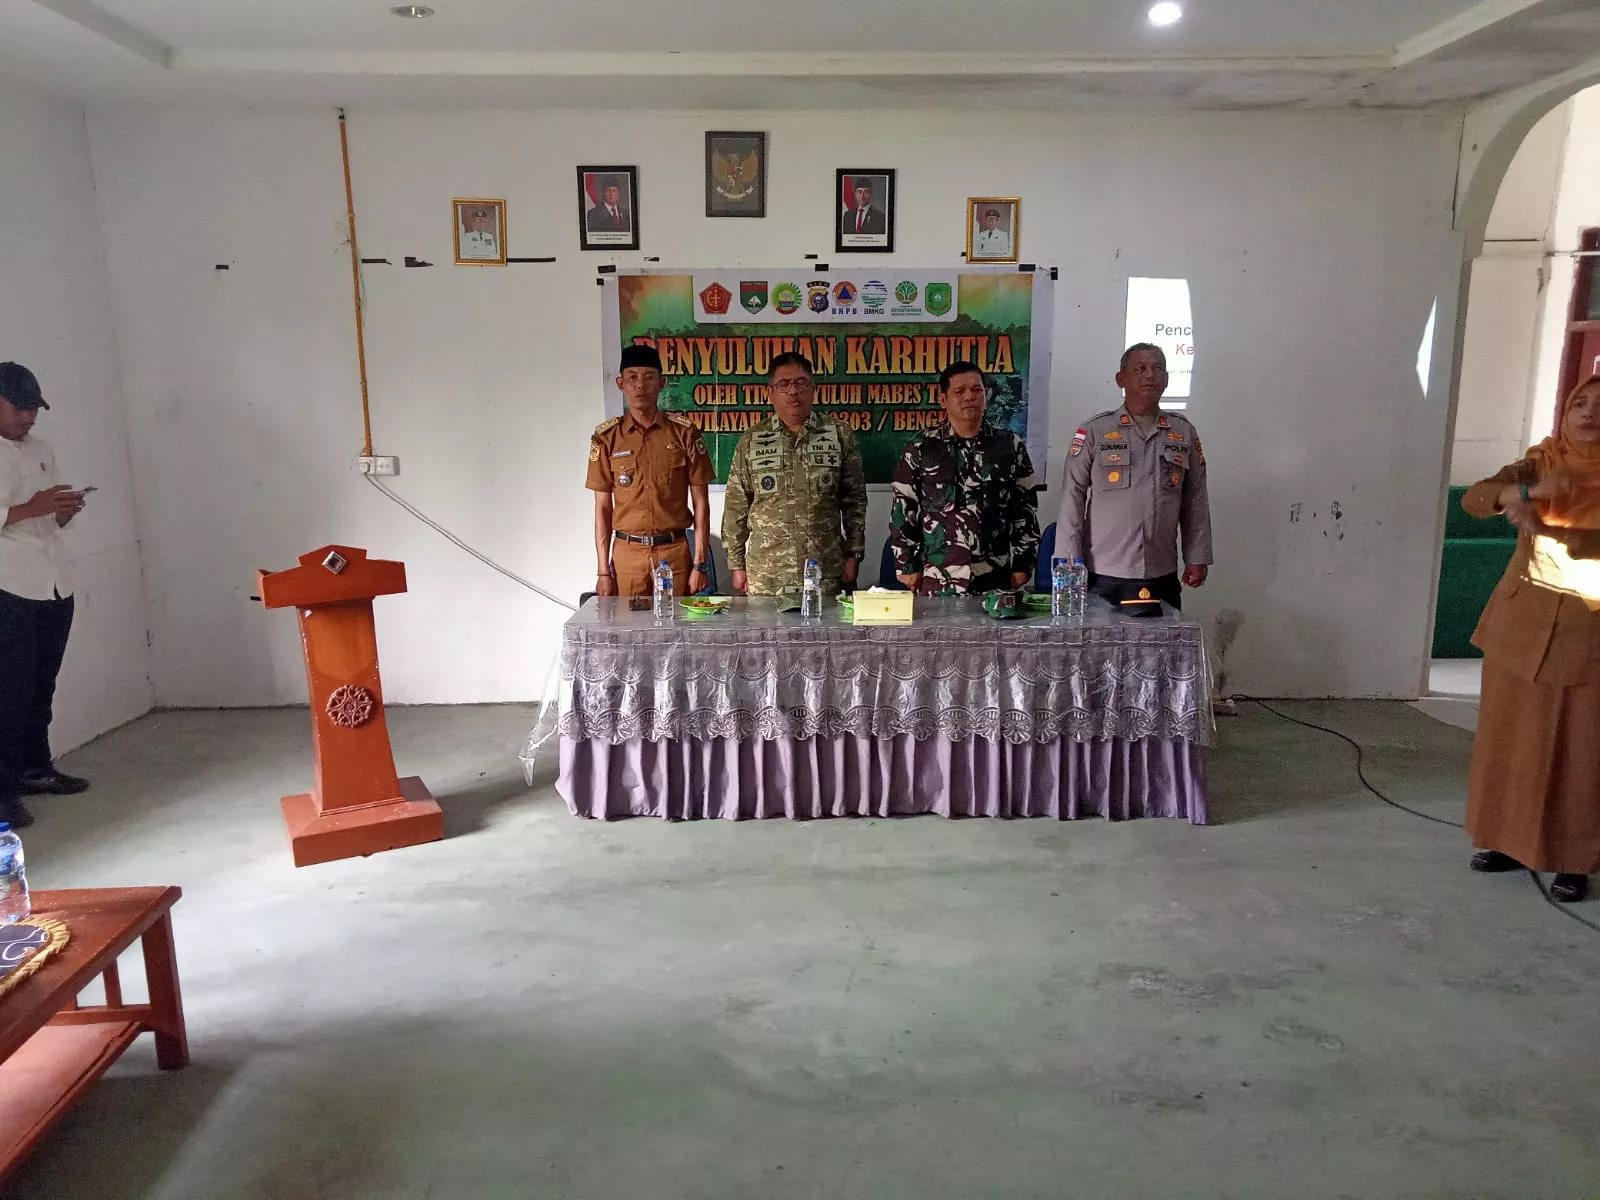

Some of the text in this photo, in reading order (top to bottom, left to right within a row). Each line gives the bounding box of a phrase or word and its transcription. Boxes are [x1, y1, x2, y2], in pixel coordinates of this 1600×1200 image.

[832, 307, 857, 316] BNPB
[864, 308, 884, 316] BMKG
[633, 335, 1014, 375] ENYULUAN KARHUTLA
[1176, 343, 1195, 356] Ke
[693, 385, 738, 405] OLEH
[867, 384, 921, 405] MABES
[926, 384, 941, 405] T
[755, 448, 777, 456] IMAM
